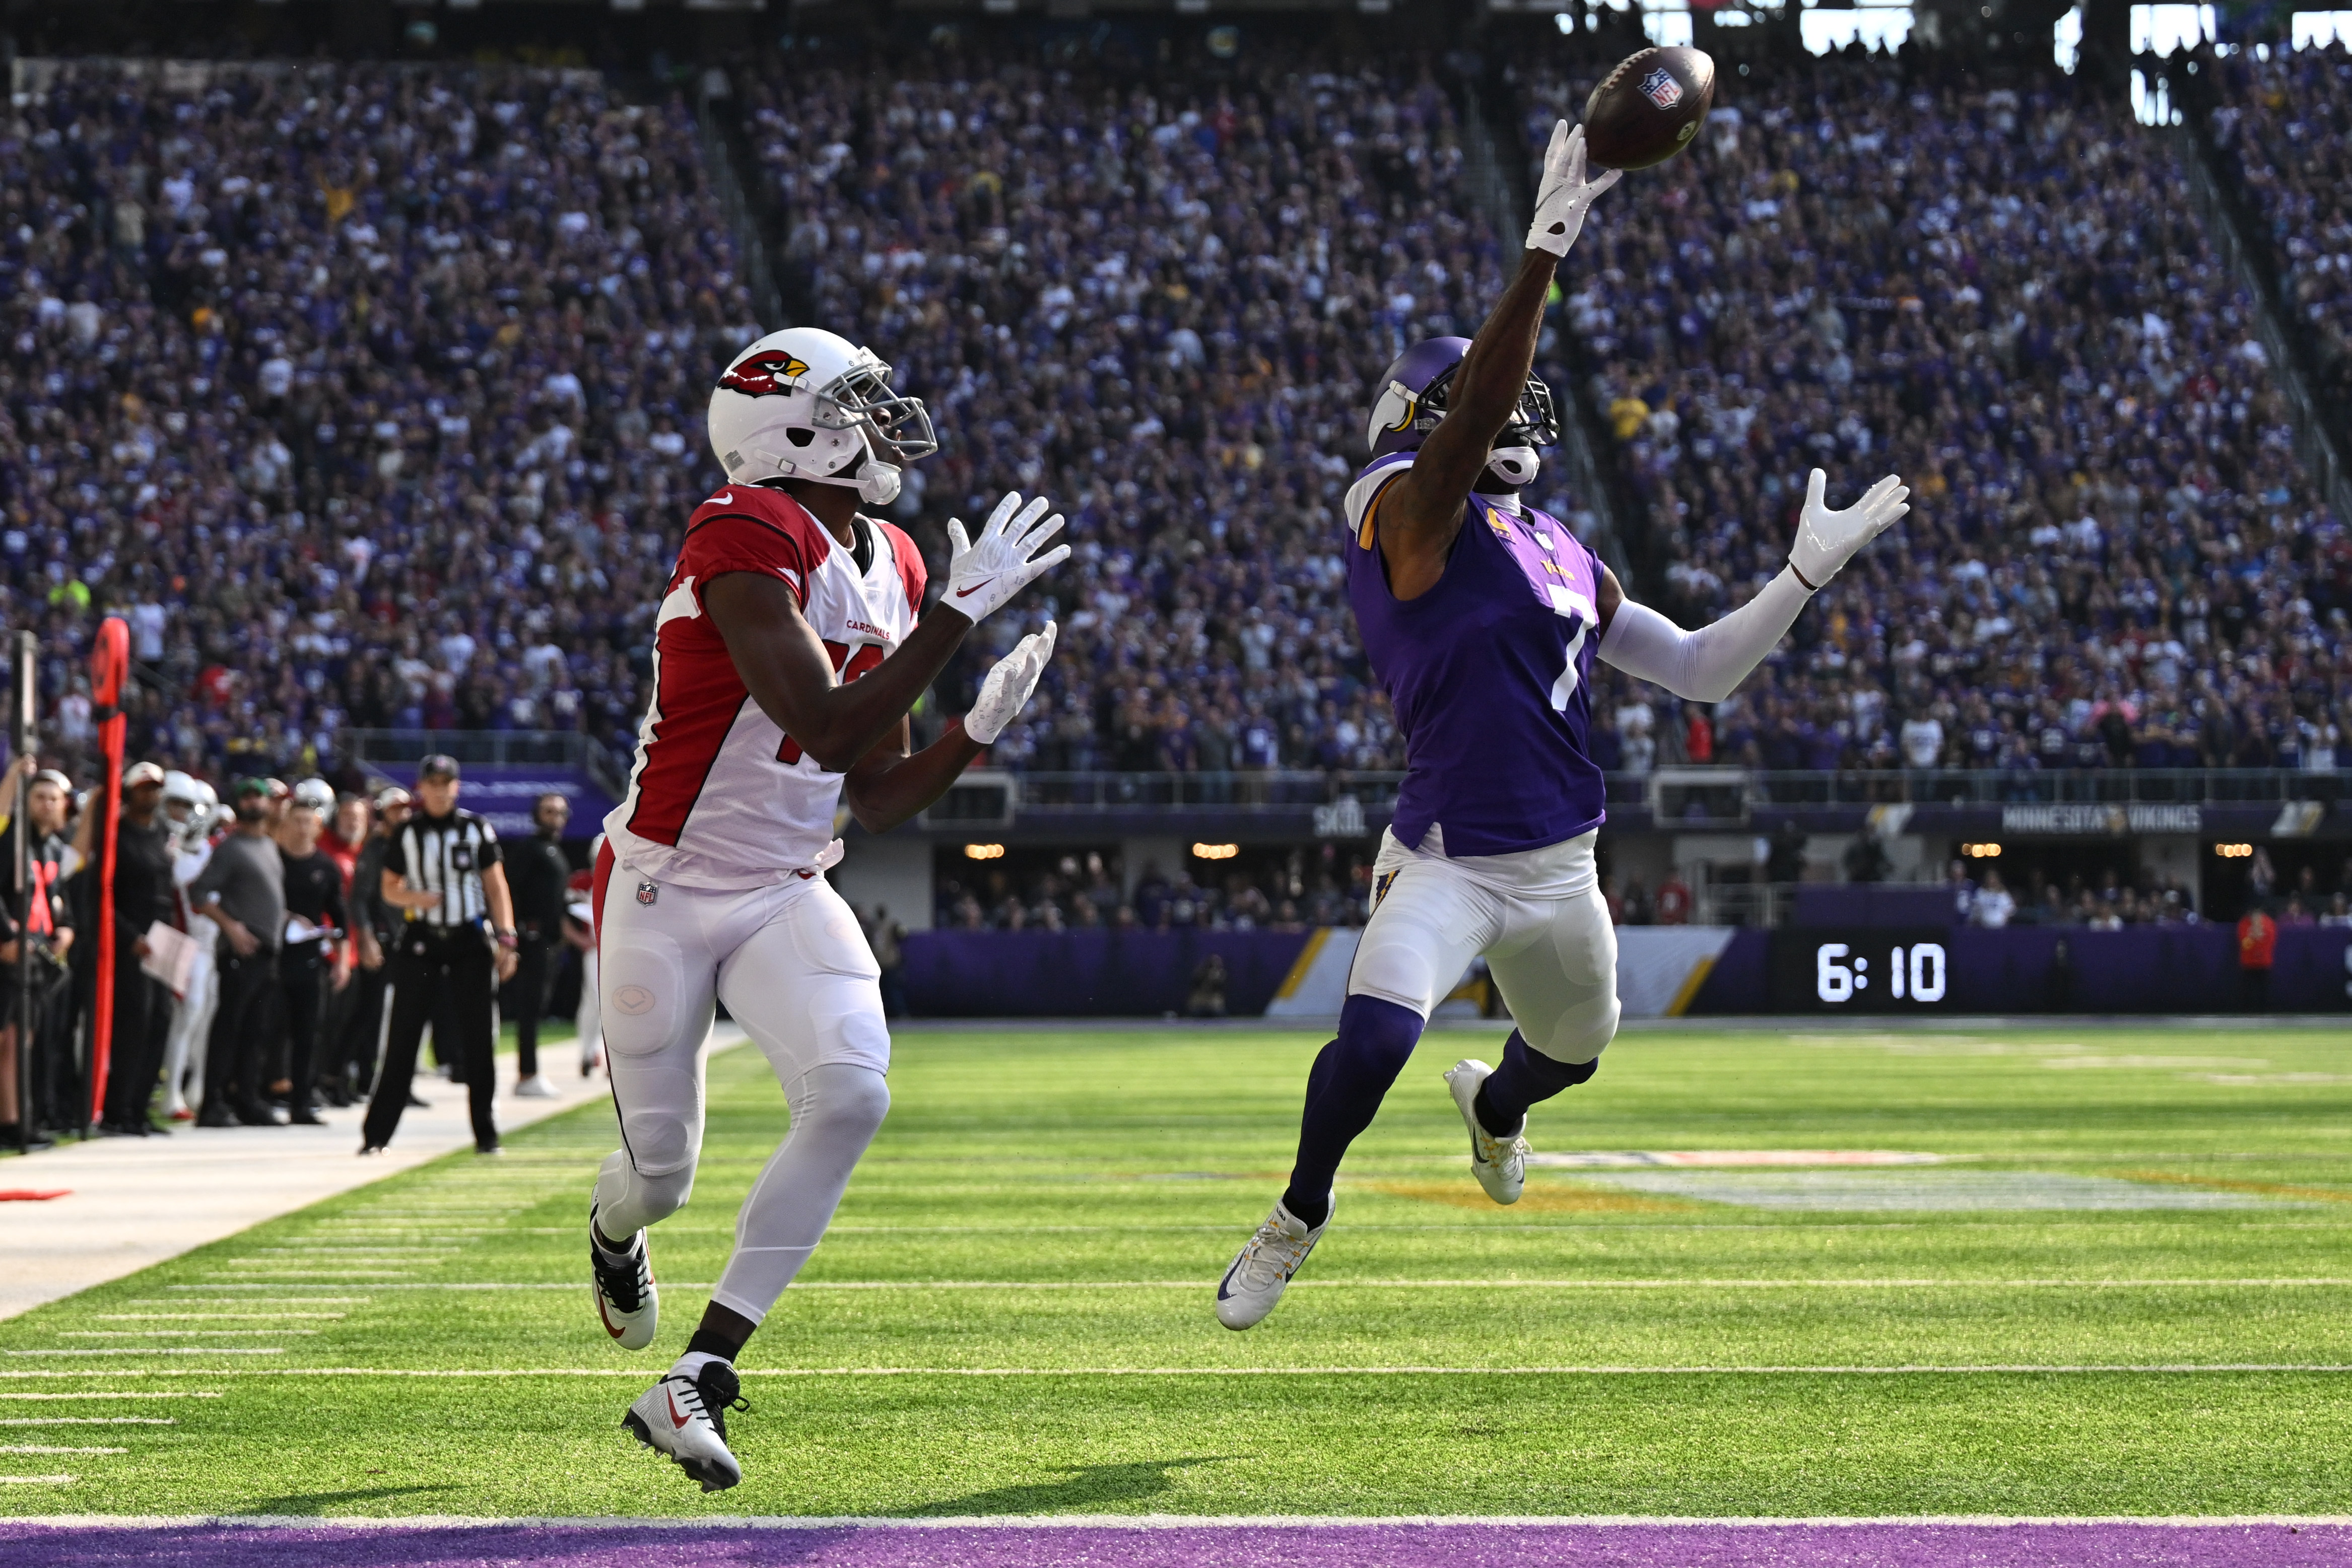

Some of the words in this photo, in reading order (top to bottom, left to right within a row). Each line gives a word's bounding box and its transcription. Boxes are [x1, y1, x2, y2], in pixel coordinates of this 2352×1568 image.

[1652, 82, 1680, 106] NFL
[846, 620, 890, 640] CARDINALS
[1546, 583, 1596, 711] 7
[639, 891, 654, 903] NFL
[1276, 1206, 1286, 1221] LSU
